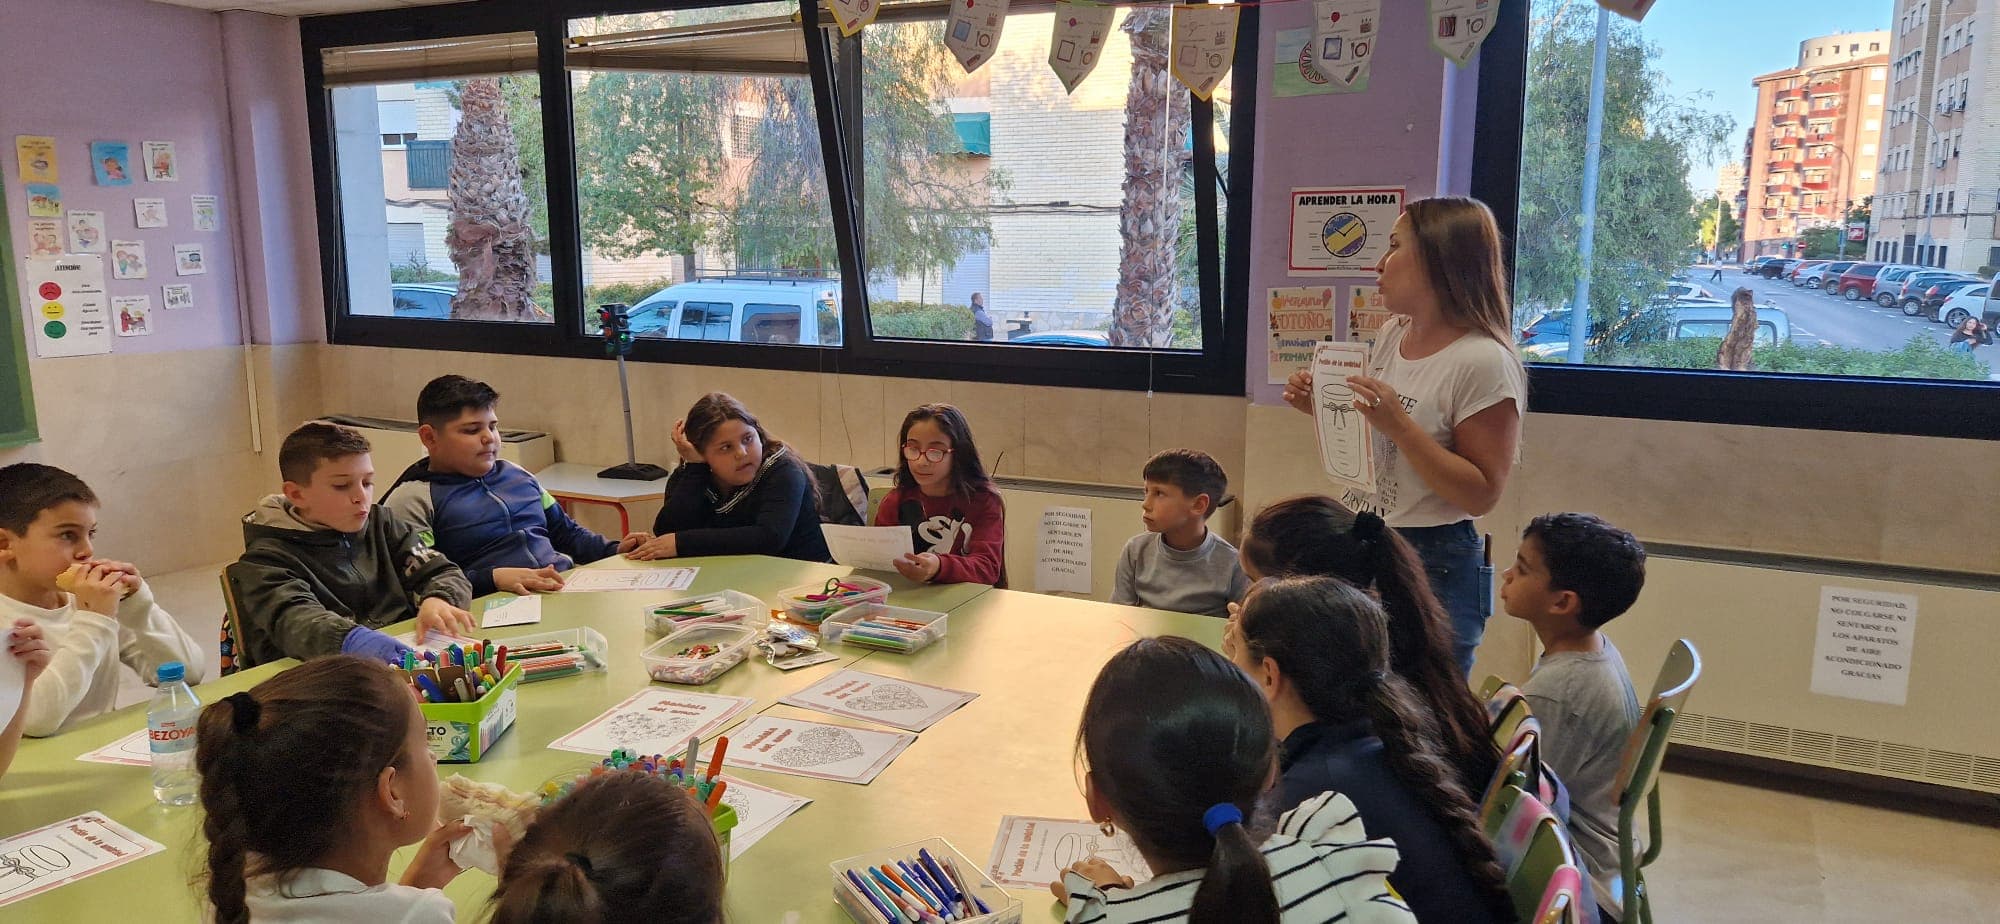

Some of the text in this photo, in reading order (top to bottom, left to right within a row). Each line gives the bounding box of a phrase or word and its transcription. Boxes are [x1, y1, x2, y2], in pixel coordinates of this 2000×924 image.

[1298, 195, 1396, 207] APRENDER LA HORA
[1831, 595, 1850, 603] POR
[1830, 607, 1843, 615] NO
[1845, 609, 1893, 620] COLGARSE
[1837, 620, 1881, 631] SENTARSE
[1853, 635, 1898, 645] APARATOS
[1861, 648, 1881, 656] AIRE
[1825, 655, 1902, 670] ACONDICIONADO
[149, 727, 196, 741] BEZOYA
[427, 726, 446, 736] TO
